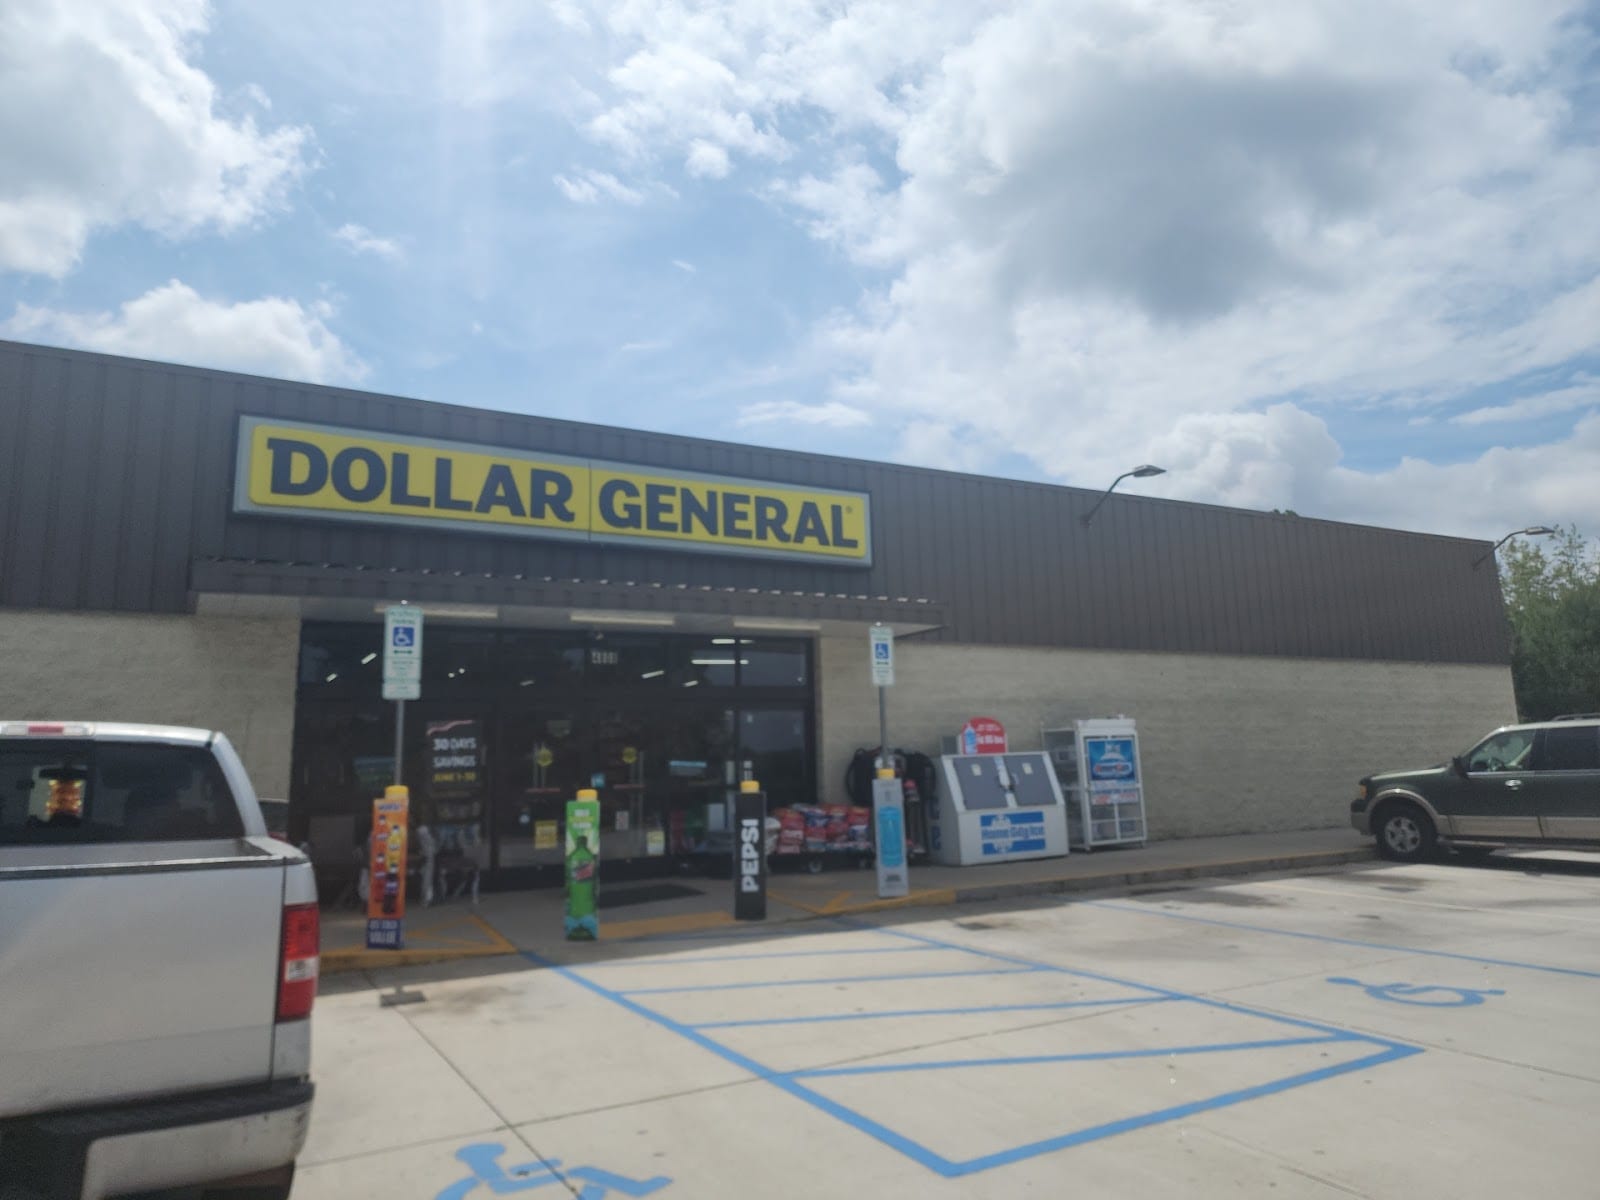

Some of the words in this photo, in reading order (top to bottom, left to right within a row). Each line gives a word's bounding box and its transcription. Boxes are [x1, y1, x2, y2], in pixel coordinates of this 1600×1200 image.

[267, 438, 575, 523] DOLLAR
[600, 479, 858, 550] GENERAL
[741, 819, 760, 893] PEPSI
